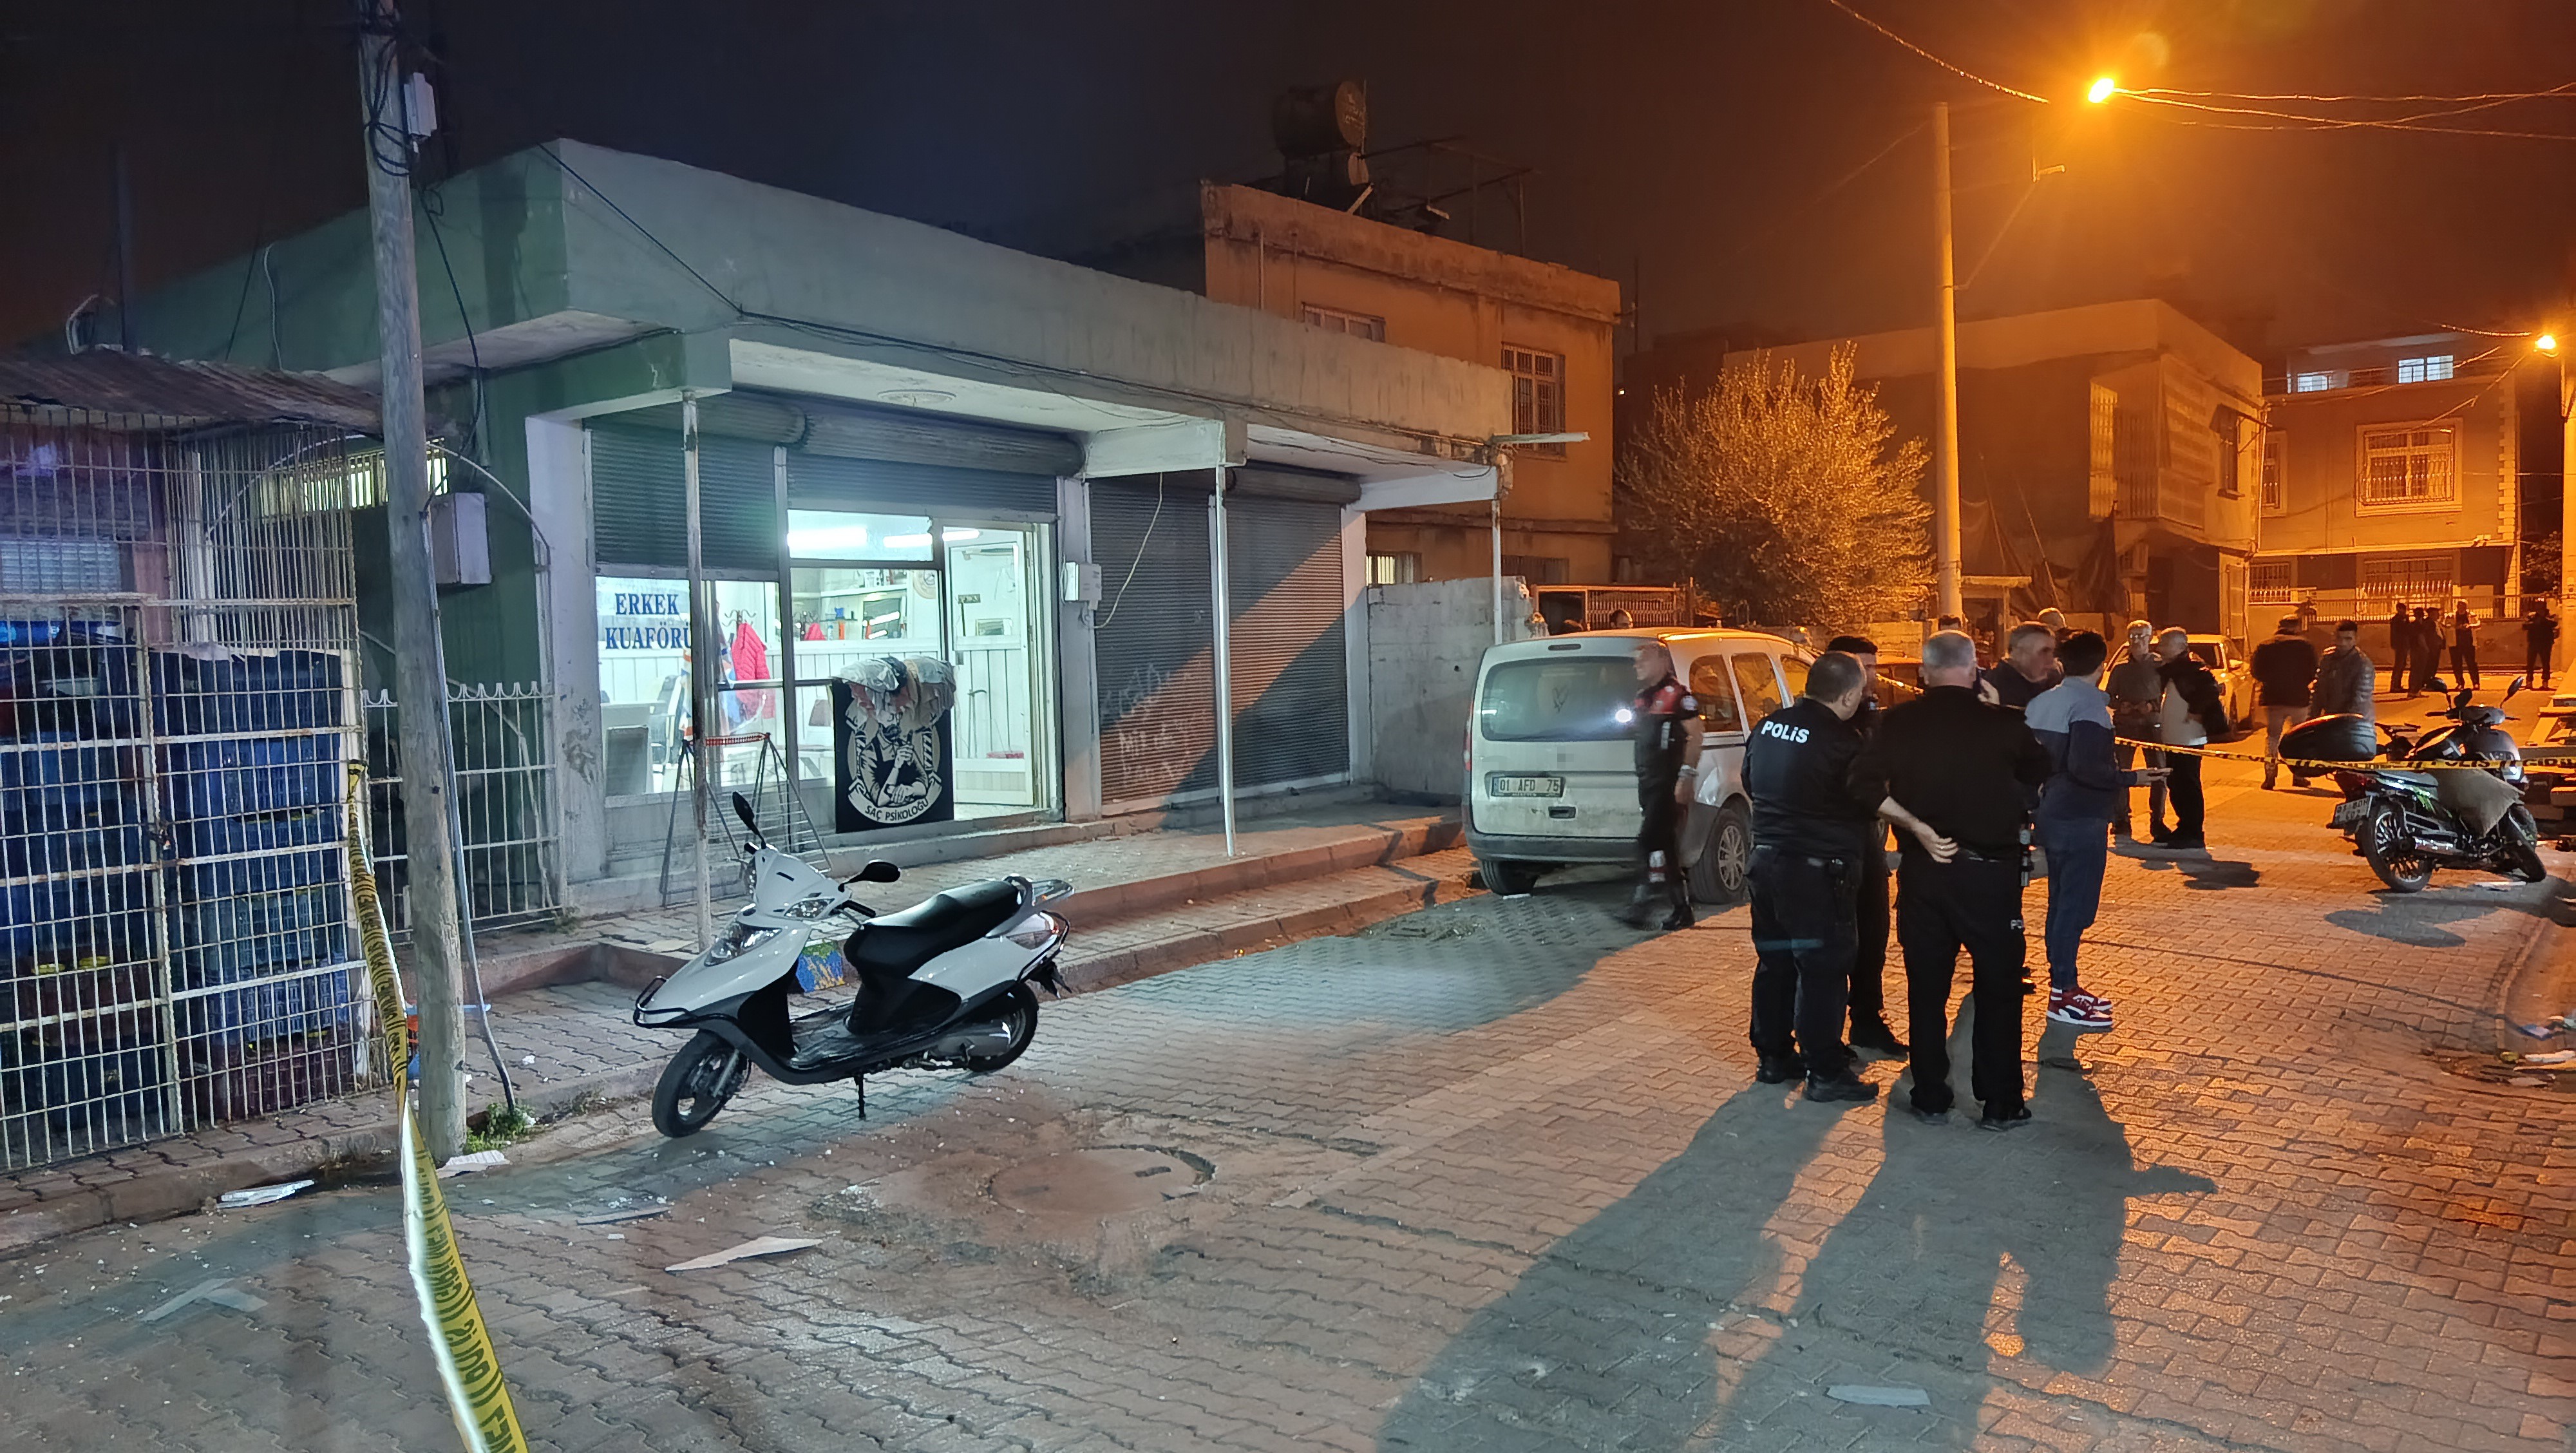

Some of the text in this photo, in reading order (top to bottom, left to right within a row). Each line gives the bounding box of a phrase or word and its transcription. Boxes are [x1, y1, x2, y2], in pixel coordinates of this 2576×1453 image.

[615, 593, 679, 615] ERKEK
[1499, 779, 1560, 792] 01 AFD 75
[865, 805, 882, 821] SAÇ
